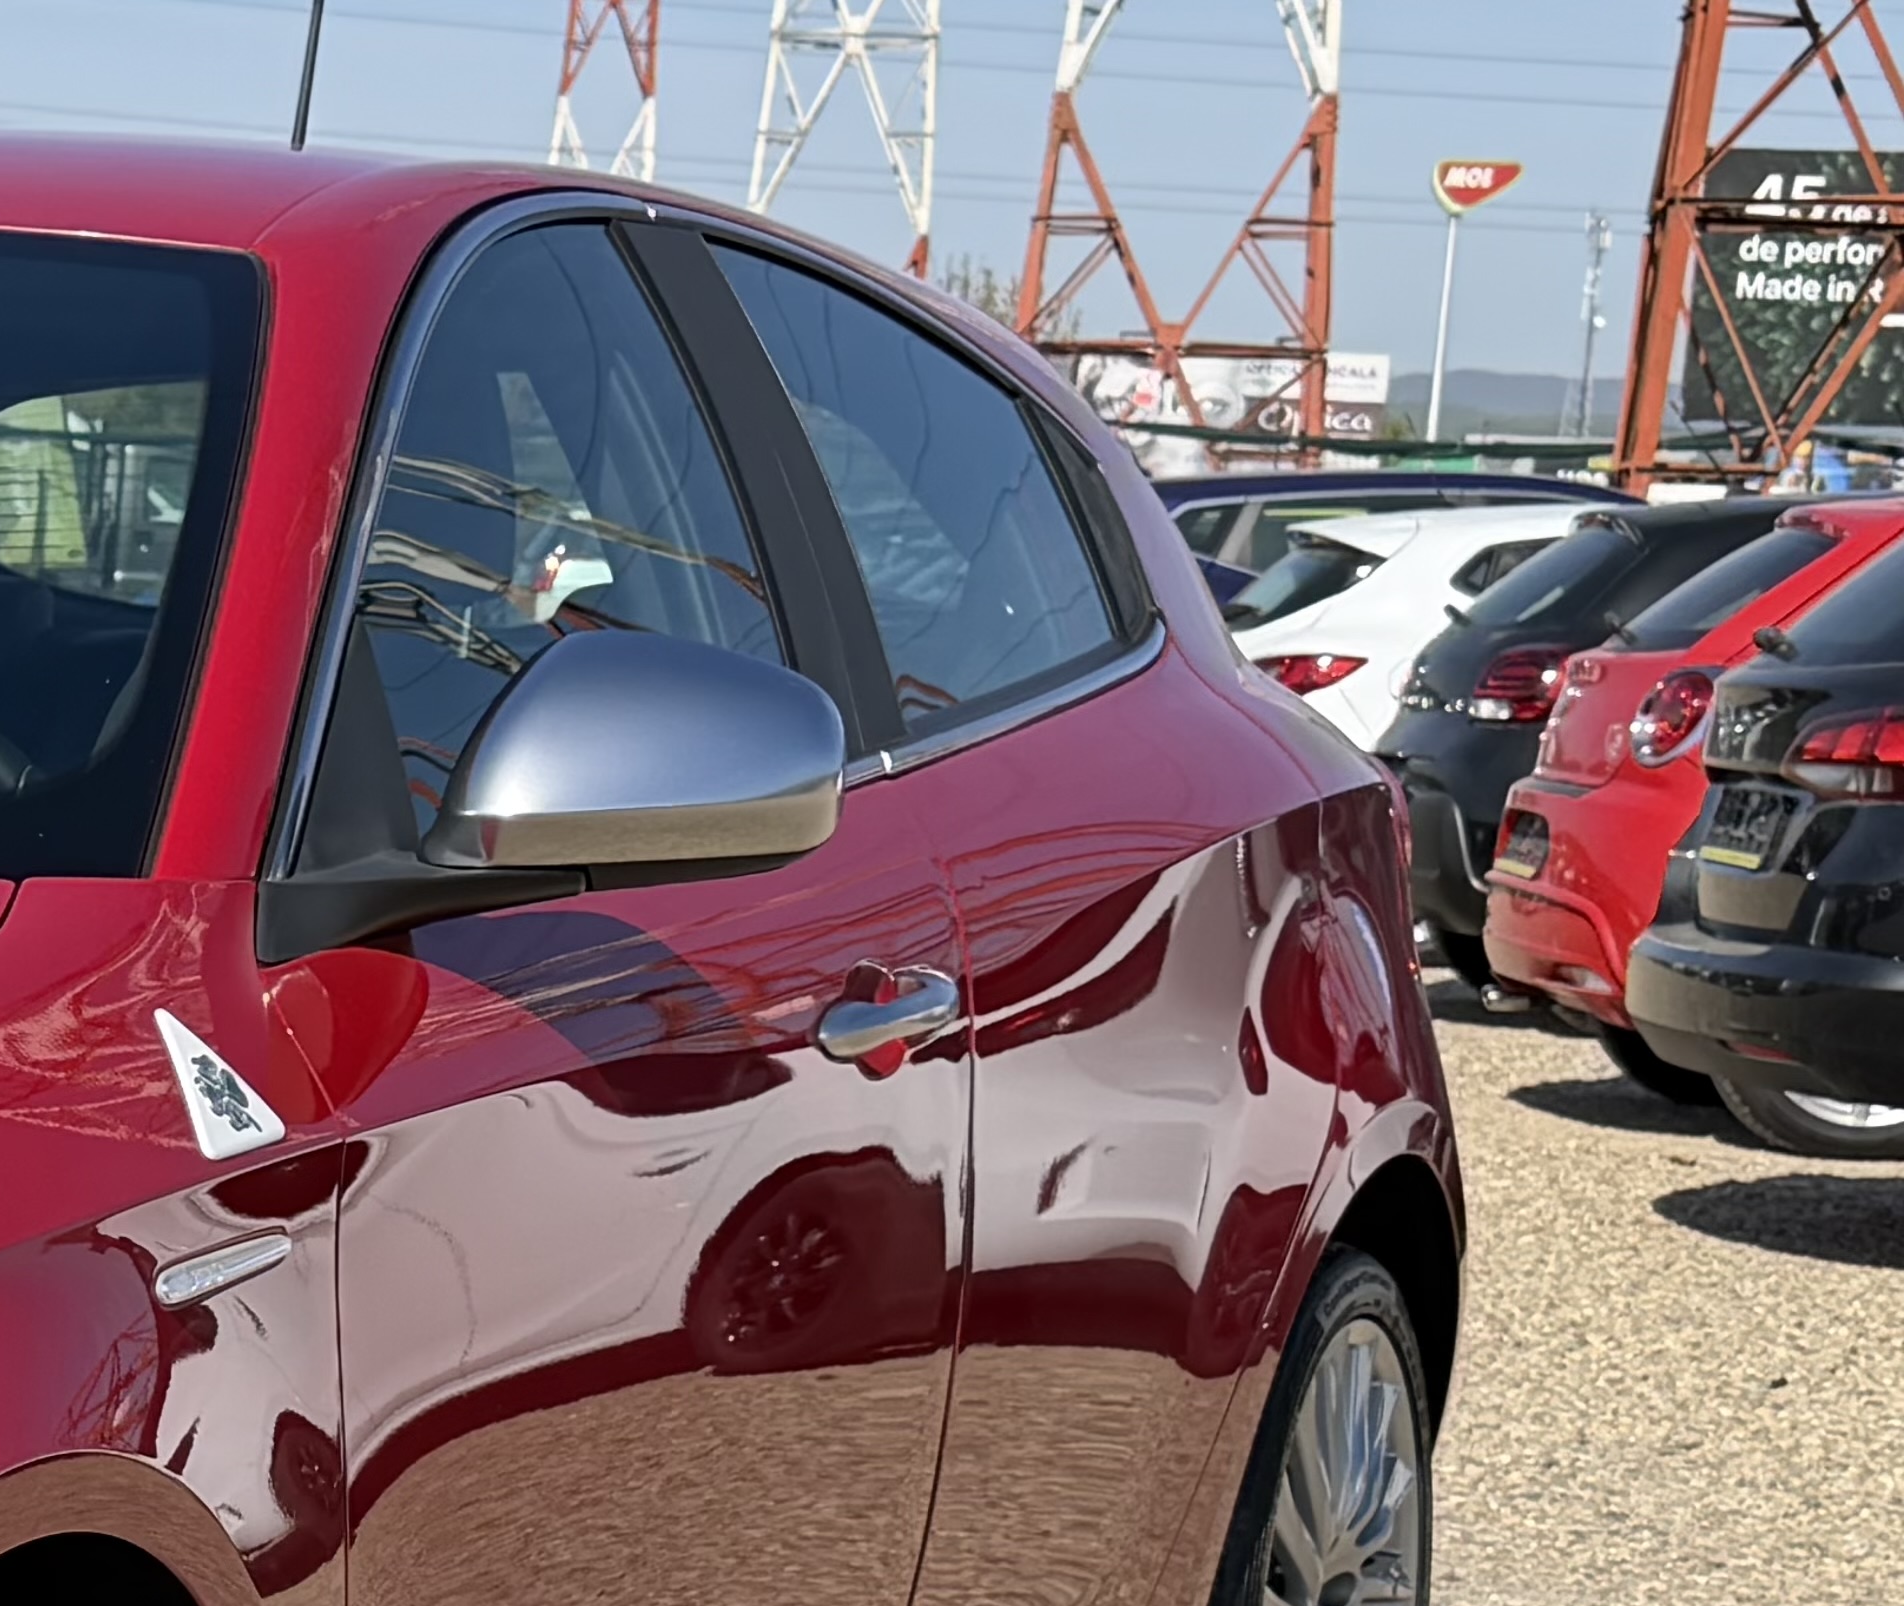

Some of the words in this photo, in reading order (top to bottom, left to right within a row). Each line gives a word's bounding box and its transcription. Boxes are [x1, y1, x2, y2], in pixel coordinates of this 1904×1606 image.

[1738, 234, 1779, 263] de
[1735, 271, 1822, 301] Made
[1827, 273, 1857, 302] in
